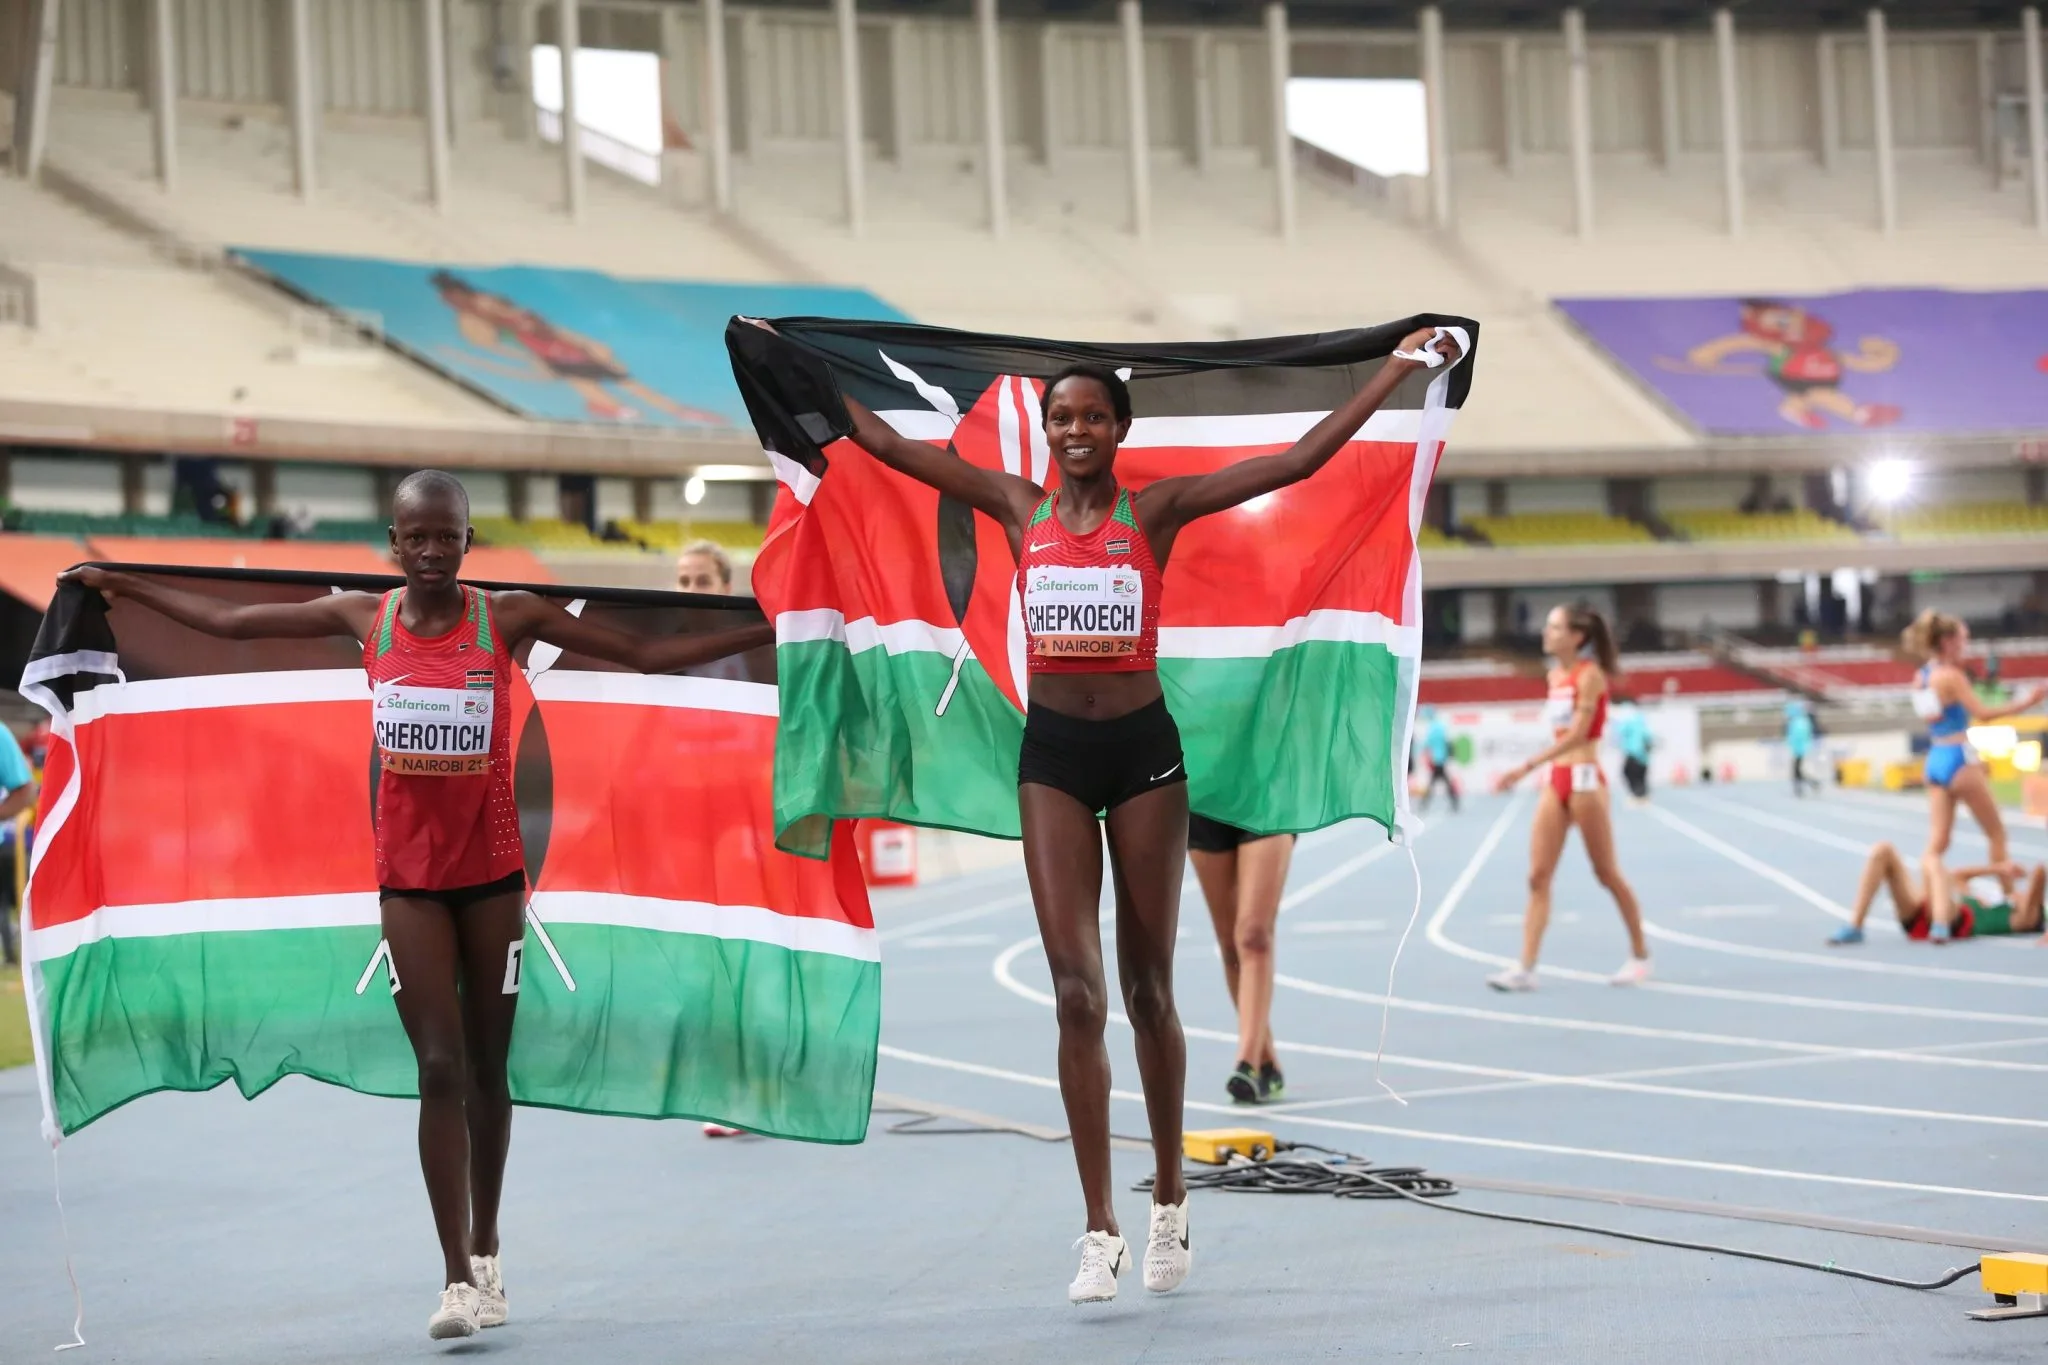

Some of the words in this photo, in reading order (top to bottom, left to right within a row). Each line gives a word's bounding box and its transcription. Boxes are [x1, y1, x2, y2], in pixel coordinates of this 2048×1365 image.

[1036, 580, 1099, 592] Safaricom
[1028, 604, 1135, 633] CHEPKOECH
[1052, 640, 1114, 653] NAIROBI
[387, 697, 450, 712] Safaricom
[376, 720, 486, 752] CHEROTICH
[402, 758, 464, 772] NAIROBI
[468, 759, 483, 771] 21
